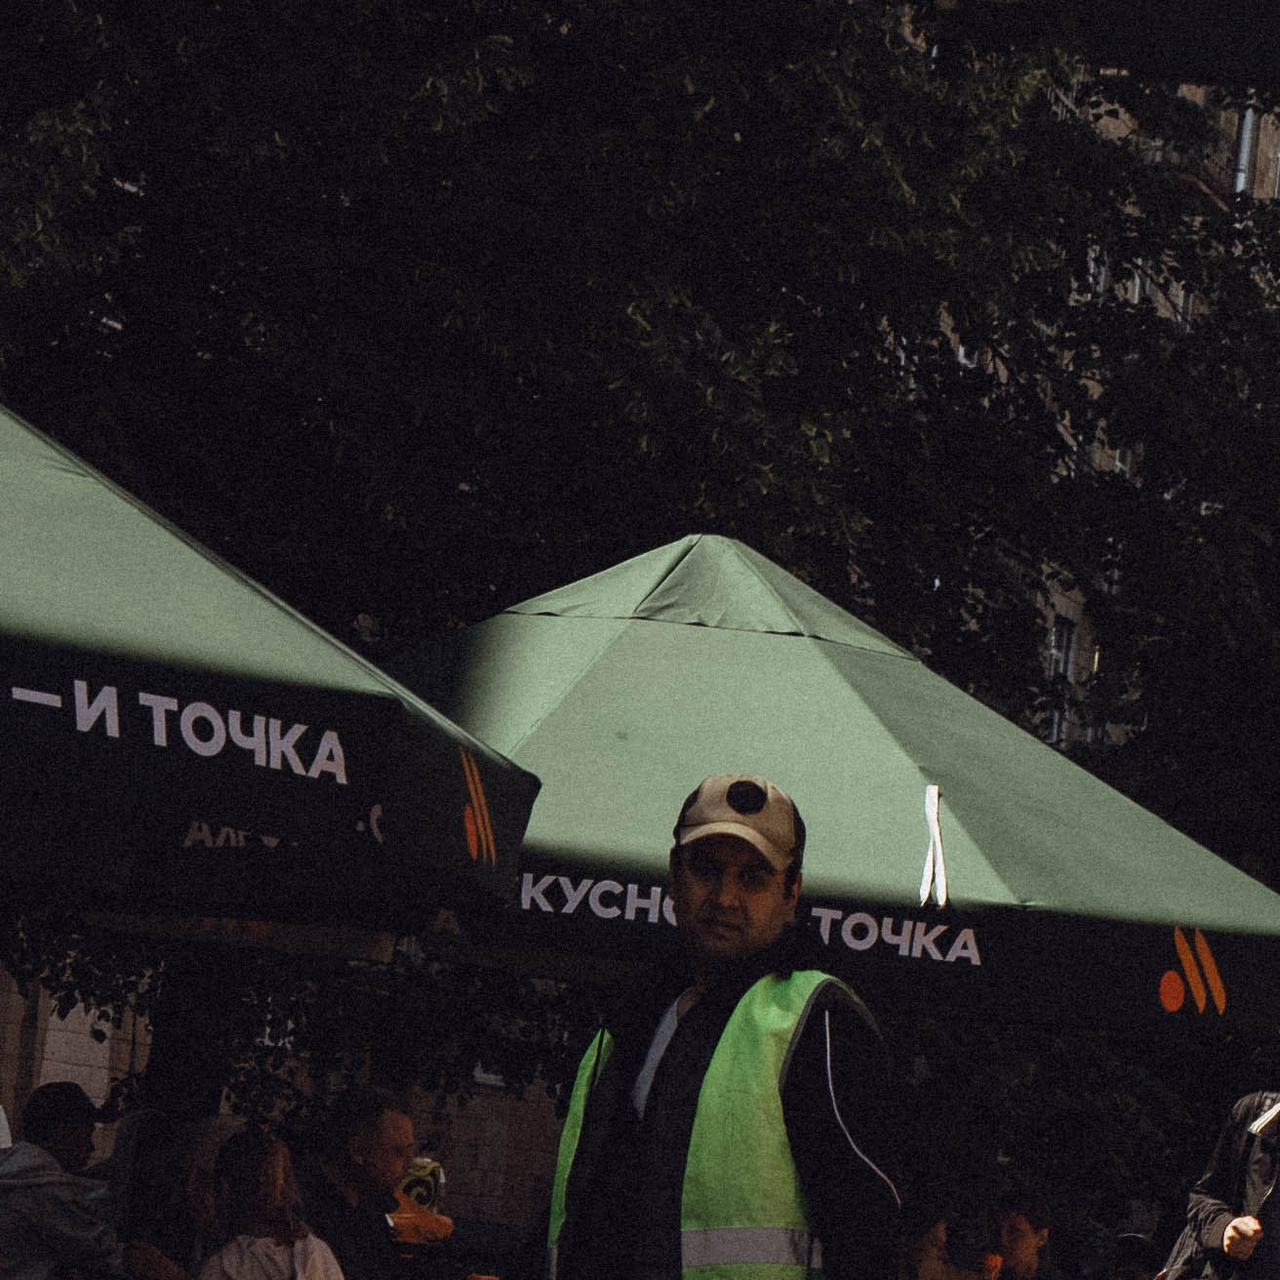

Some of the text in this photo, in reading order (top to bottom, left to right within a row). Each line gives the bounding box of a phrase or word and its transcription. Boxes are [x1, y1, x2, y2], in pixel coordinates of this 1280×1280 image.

[138, 692, 349, 785] ТОЧКА
[516, 873, 982, 968] КУСН ТОЧКА
